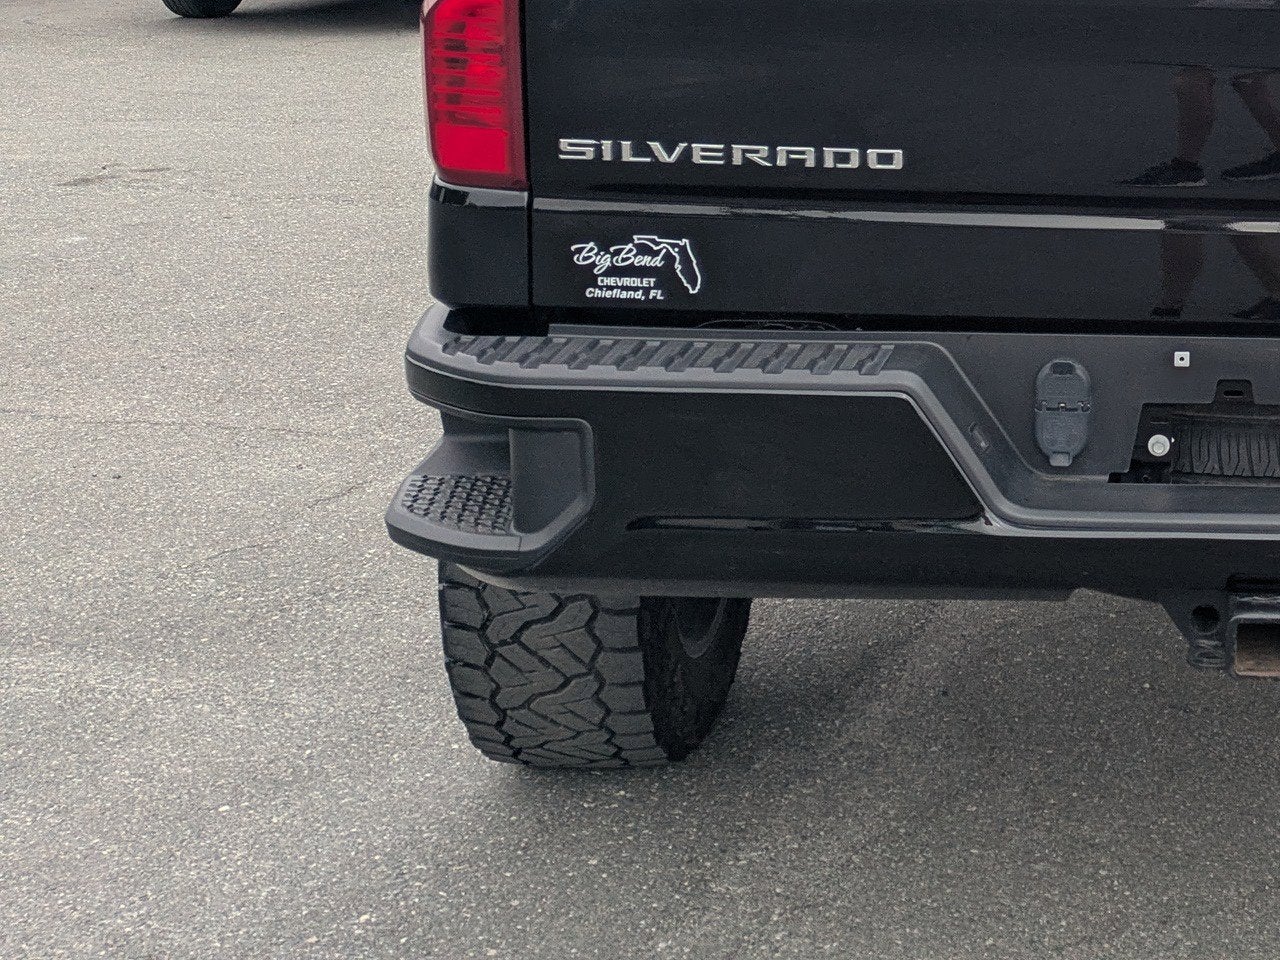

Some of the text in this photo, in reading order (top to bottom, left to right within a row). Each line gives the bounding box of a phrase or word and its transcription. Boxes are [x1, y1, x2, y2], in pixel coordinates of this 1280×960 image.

[558, 138, 904, 170] SILVERADO
[570, 241, 667, 274] Big Bend
[597, 276, 656, 287] CHEVROLET
[585, 287, 665, 300] Chiefland, FL
